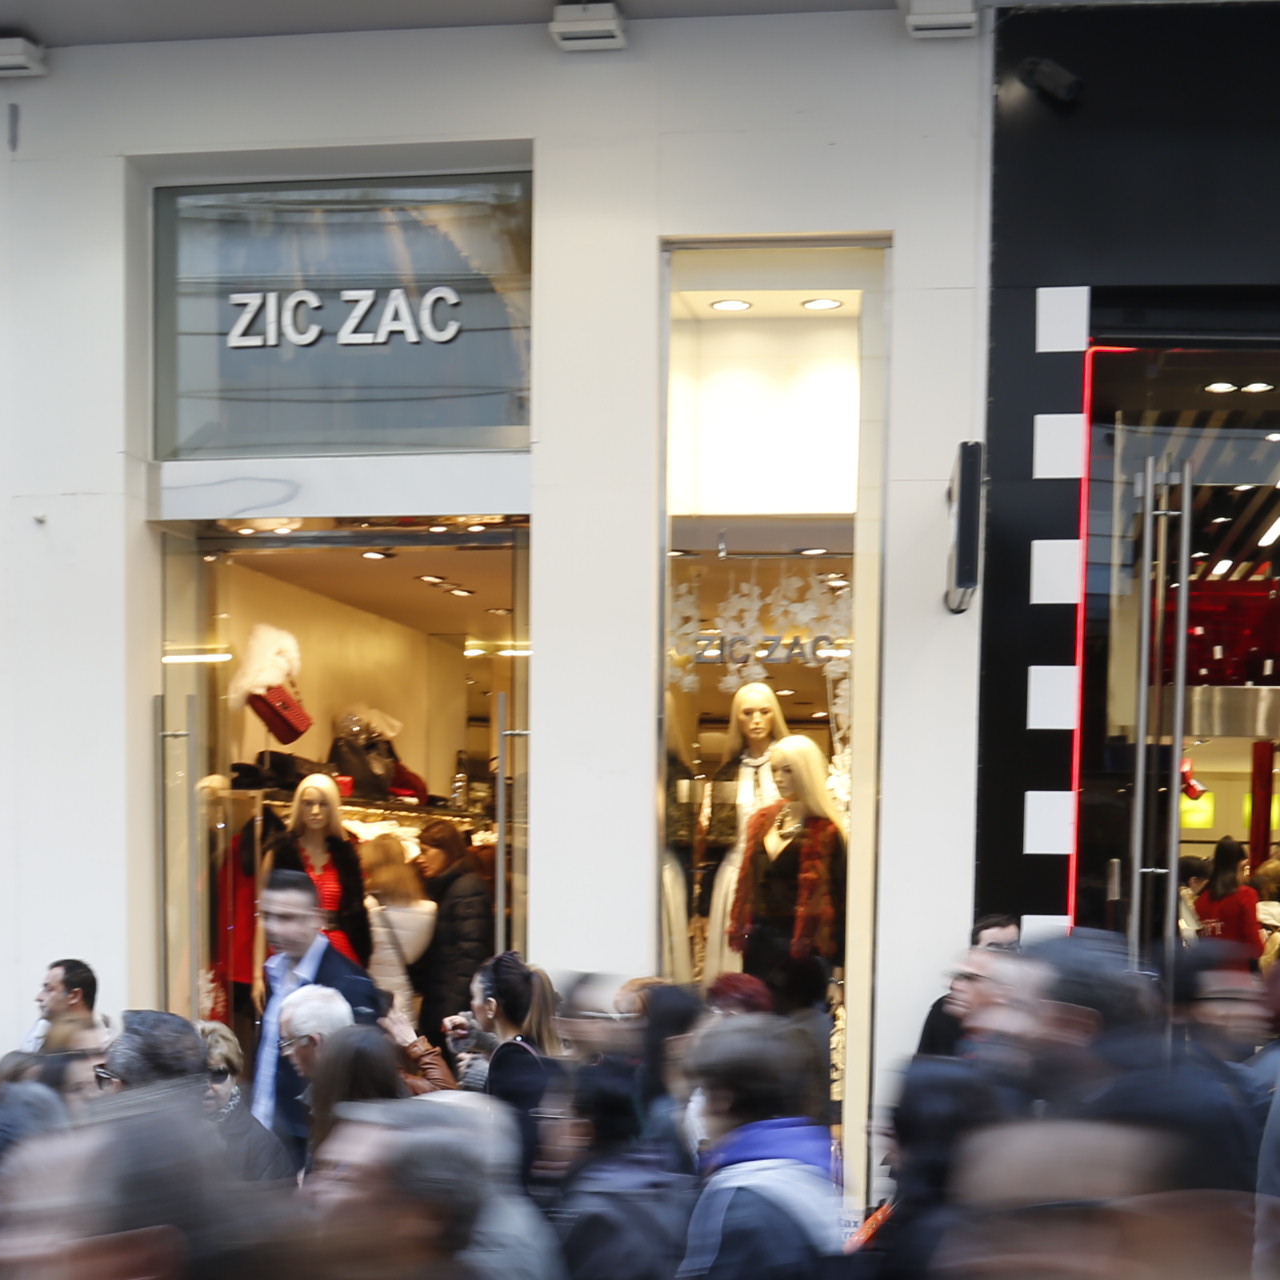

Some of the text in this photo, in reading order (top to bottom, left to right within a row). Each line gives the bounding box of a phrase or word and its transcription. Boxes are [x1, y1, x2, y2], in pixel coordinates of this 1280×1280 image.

[227, 286, 461, 347] ZIC ZAC
[695, 635, 749, 663] ZIC
